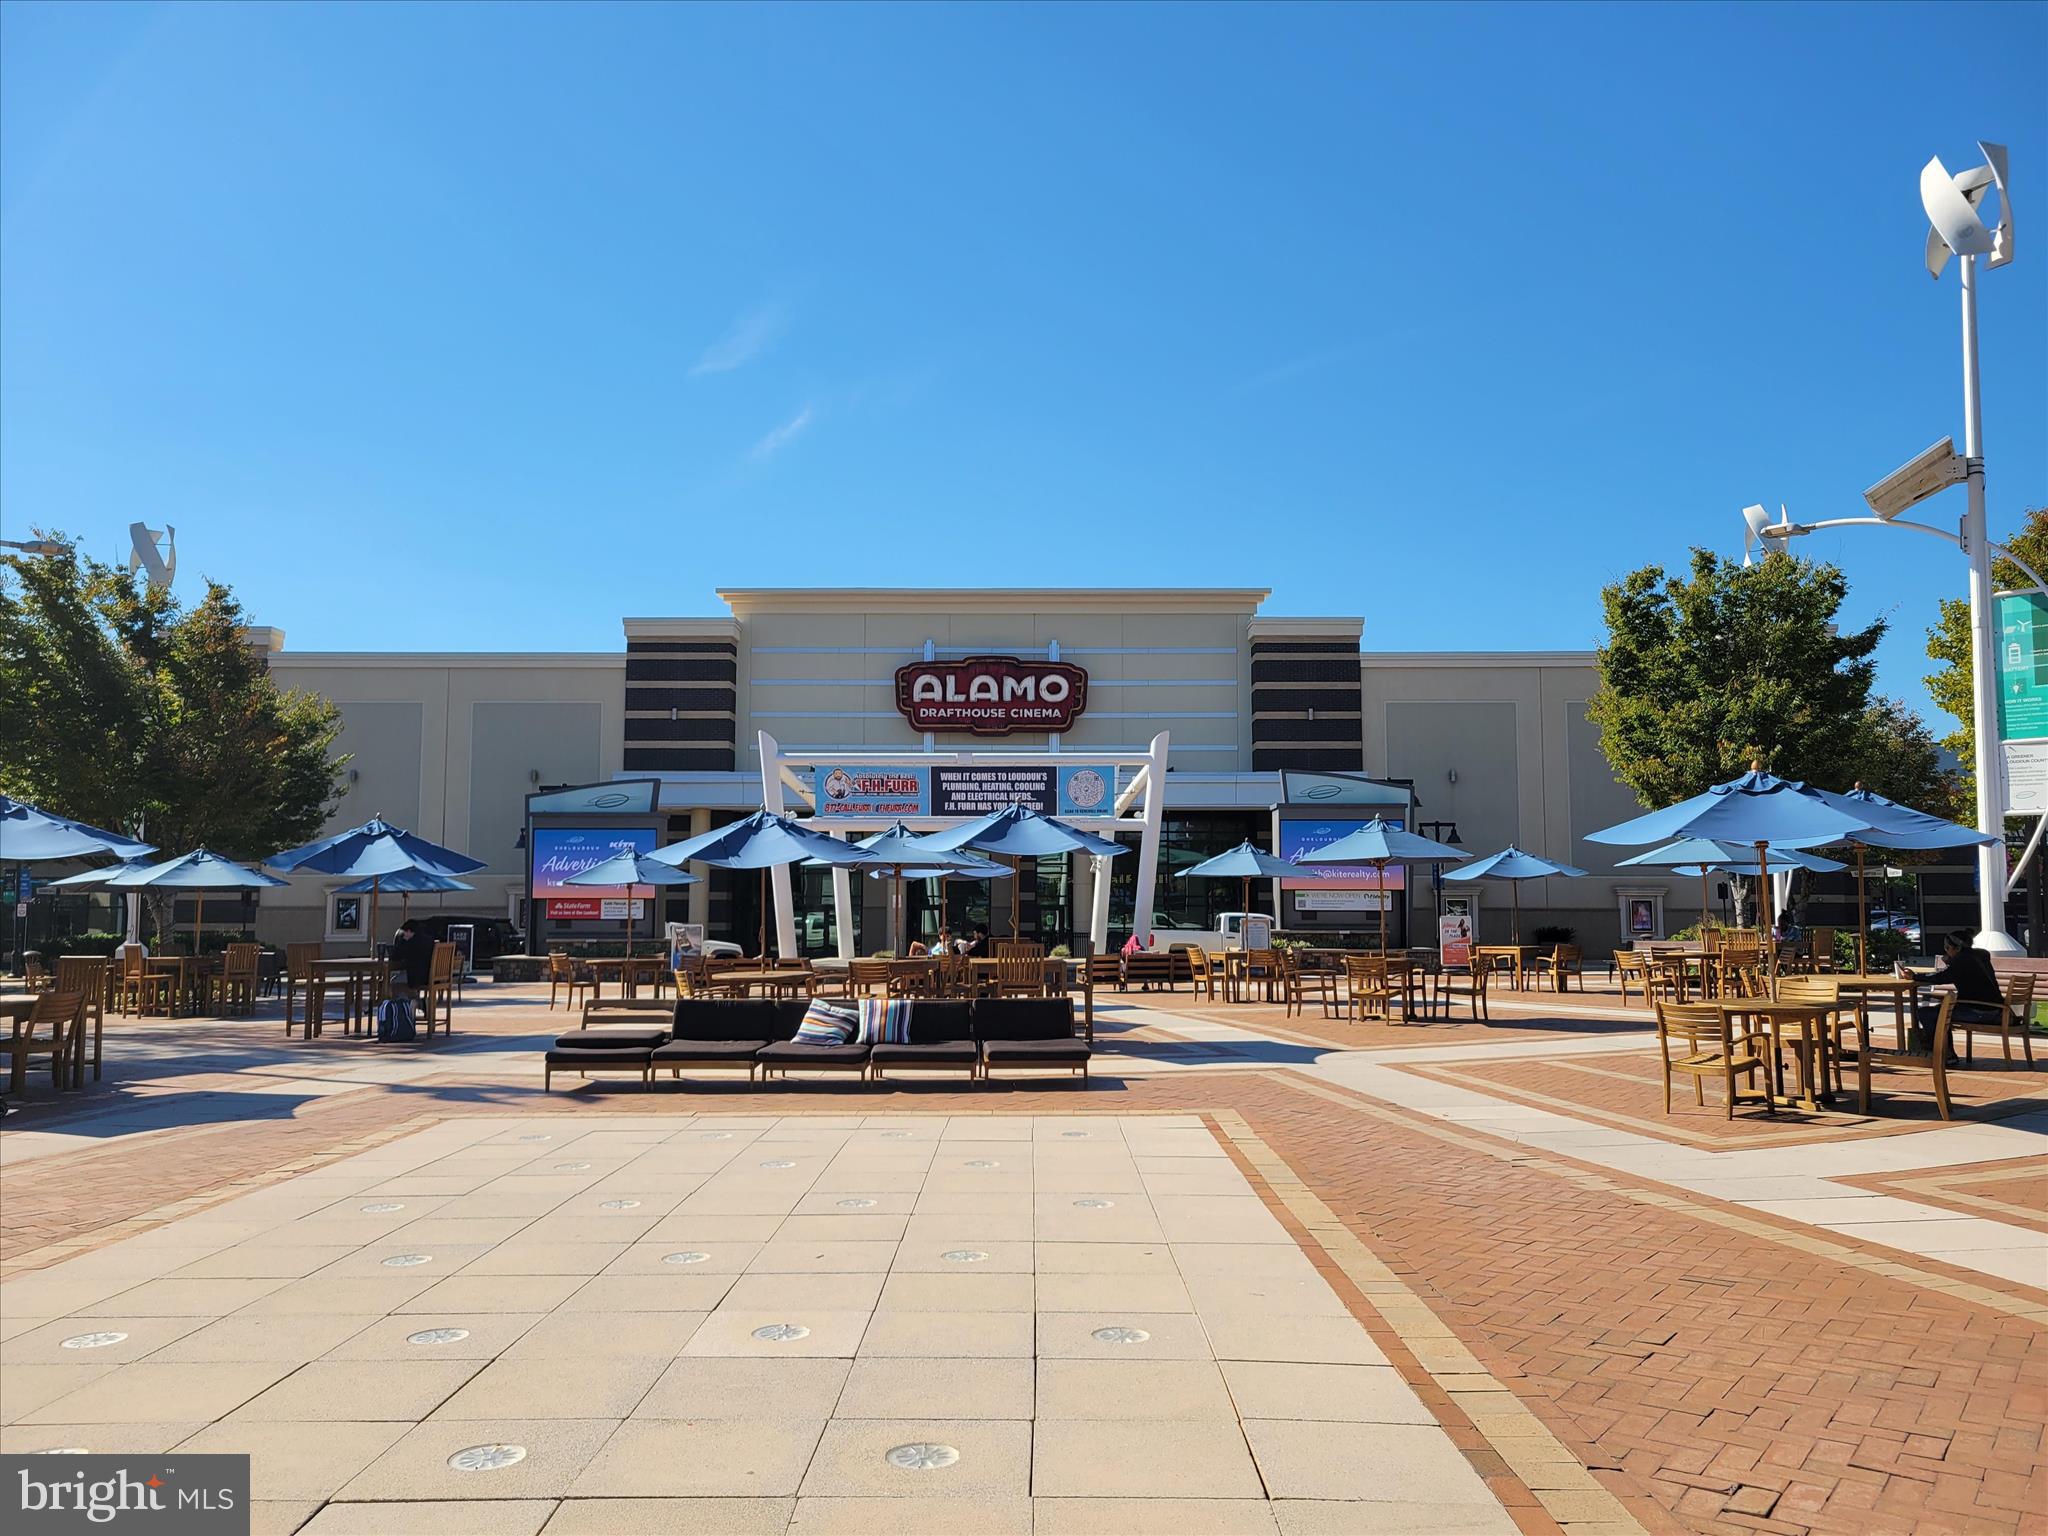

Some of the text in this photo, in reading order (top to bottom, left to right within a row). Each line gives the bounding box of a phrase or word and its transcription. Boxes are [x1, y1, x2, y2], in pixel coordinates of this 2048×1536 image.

[913, 674, 1069, 702] ALAMO
[920, 708, 1062, 718] DRAFTHOUSE CINEMA
[940, 772, 1048, 781] WHEN IT COMES TO LOUDOUN'S
[942, 782, 1046, 792] PLUMBING, HEATING, COOLING
[951, 792, 966, 801] AND
[967, 792, 1009, 801] ELECTRICAL
[958, 802, 977, 811] FURR
[978, 802, 992, 811] HAS
